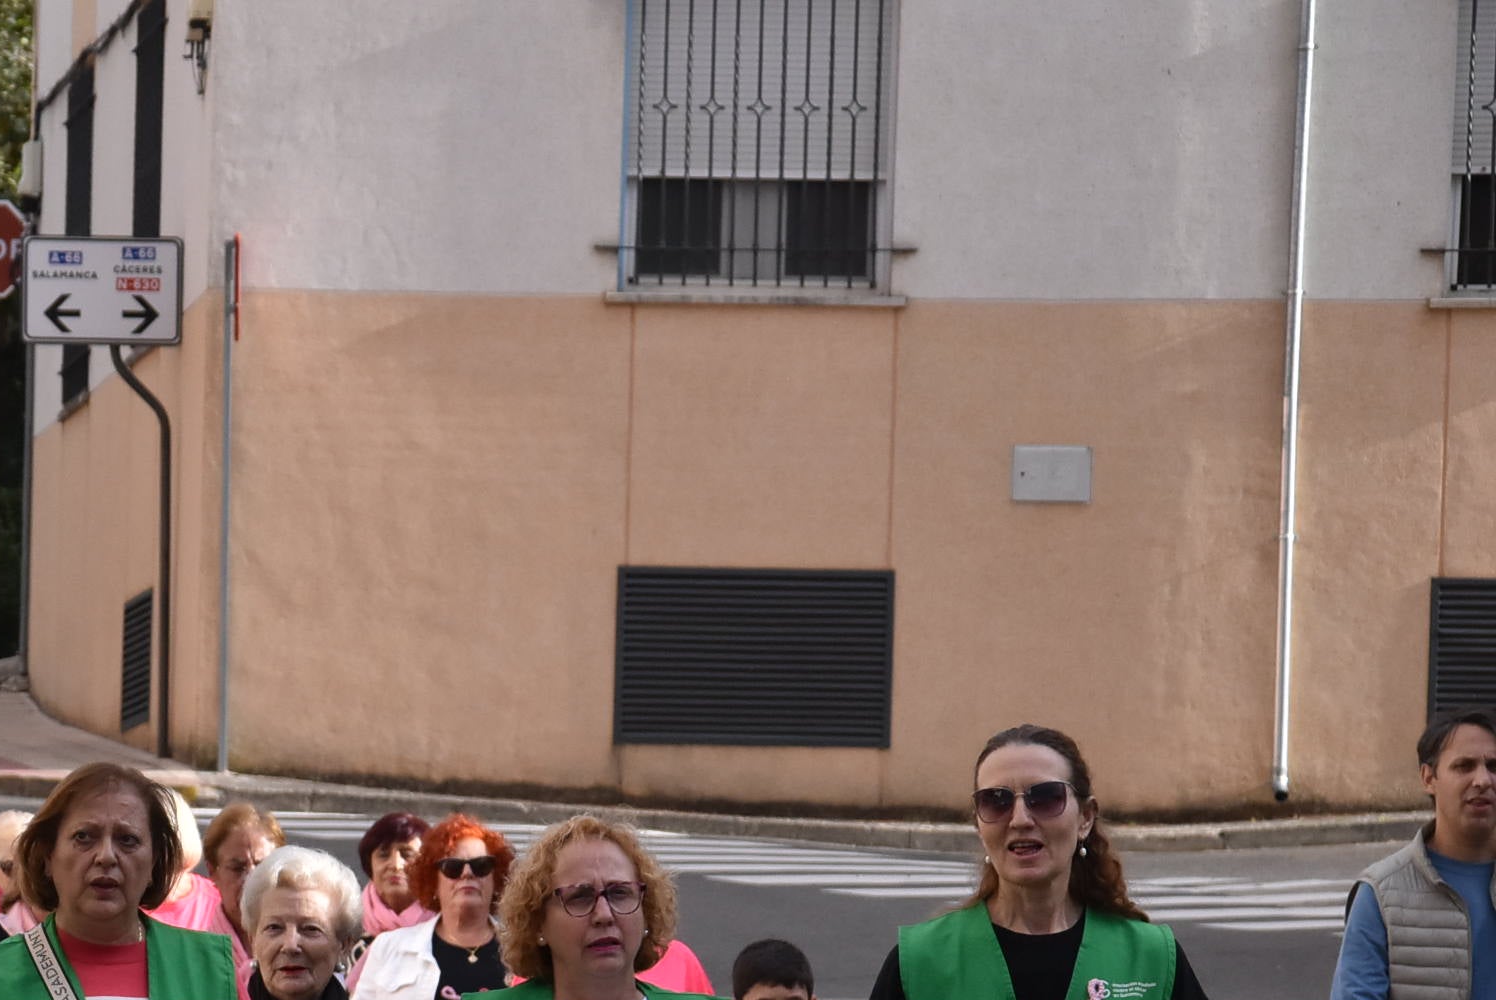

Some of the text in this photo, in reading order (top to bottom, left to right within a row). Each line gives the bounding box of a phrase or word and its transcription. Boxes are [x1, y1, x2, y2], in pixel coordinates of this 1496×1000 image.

[51, 251, 81, 263] A-66
[124, 247, 155, 259] A-66
[31, 270, 98, 279] SALAMANCA
[117, 279, 159, 290] N-630
